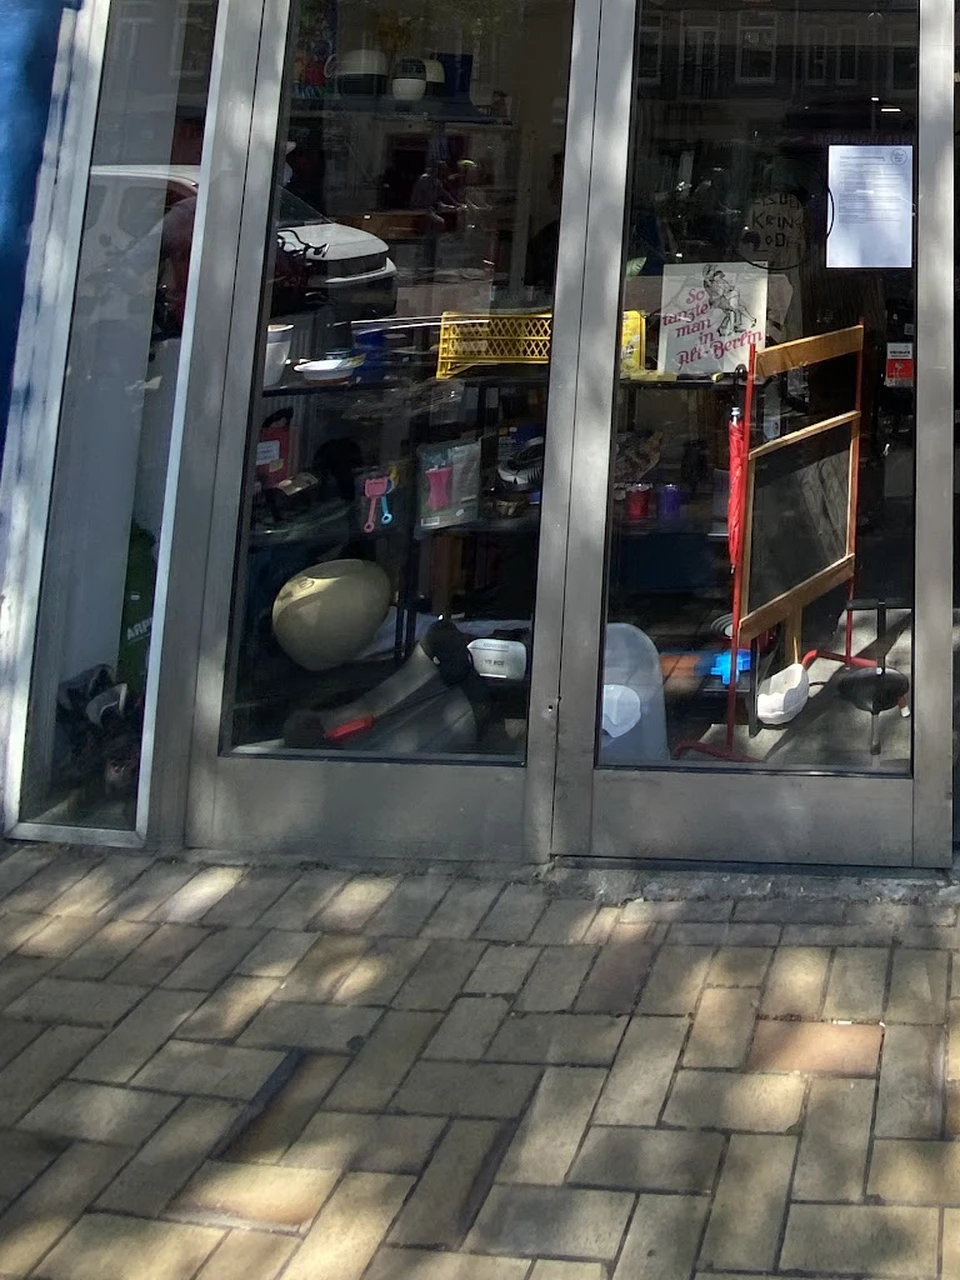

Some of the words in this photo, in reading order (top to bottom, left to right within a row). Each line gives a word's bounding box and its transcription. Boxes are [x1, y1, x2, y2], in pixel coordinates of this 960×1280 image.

[686, 288, 705, 304] So
[676, 319, 712, 338] man
[699, 330, 717, 346] in
[127, 617, 153, 640] ARP
